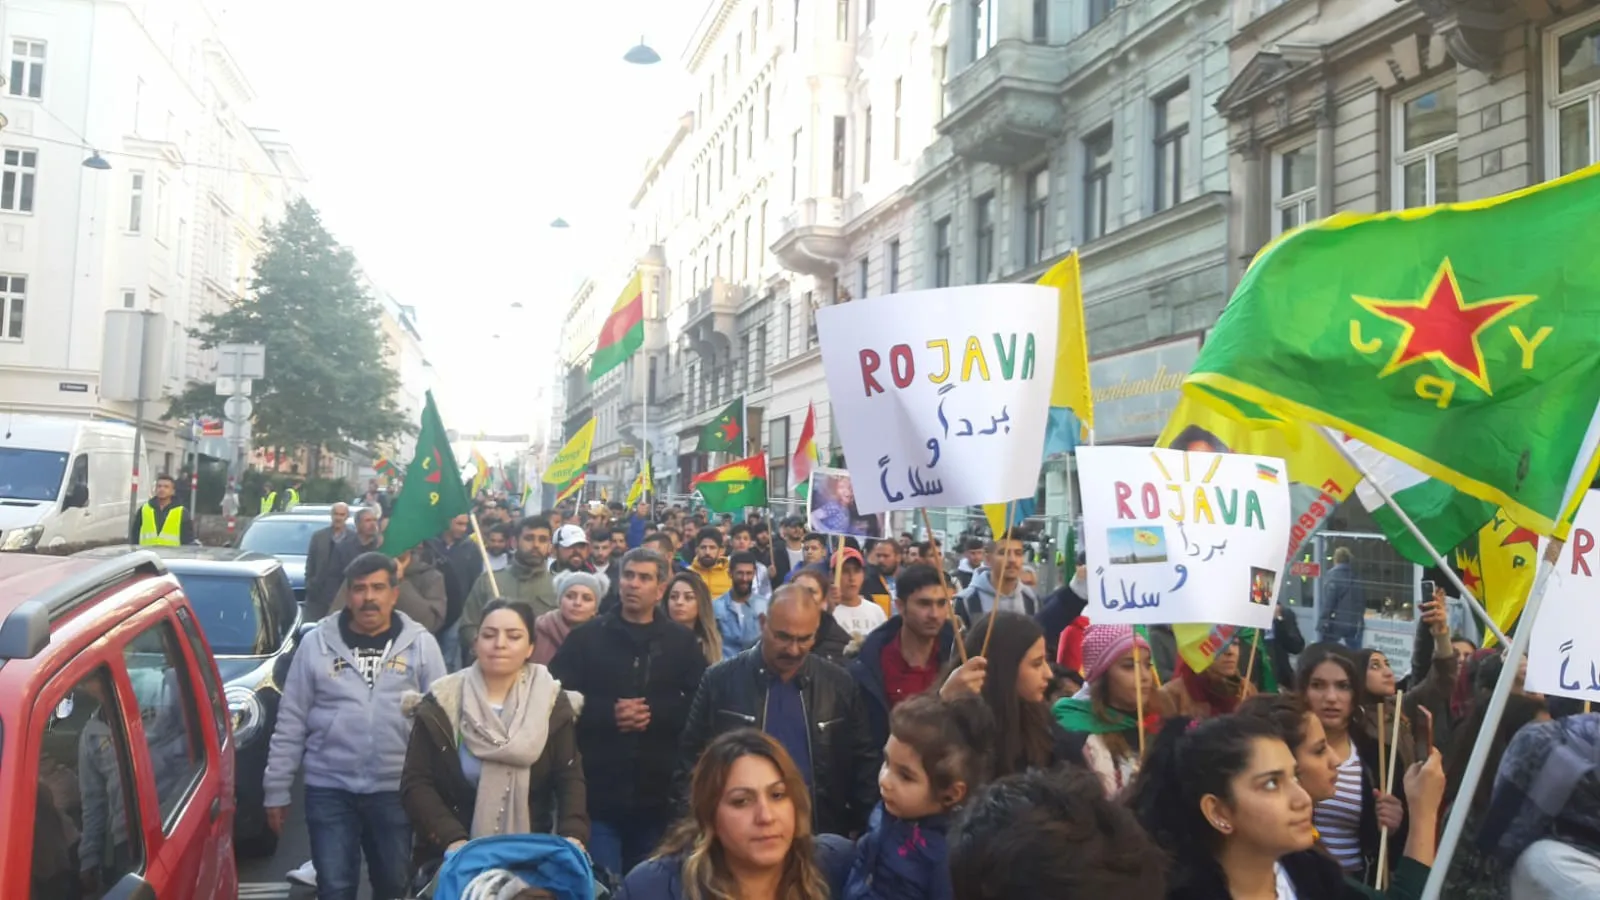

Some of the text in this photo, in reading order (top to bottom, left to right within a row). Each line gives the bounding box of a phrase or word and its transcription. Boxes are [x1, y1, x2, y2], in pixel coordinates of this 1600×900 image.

[858, 332, 1036, 398] ROJAVA
[1114, 481, 1266, 531] ROJAVA
[1571, 528, 1600, 577] R
